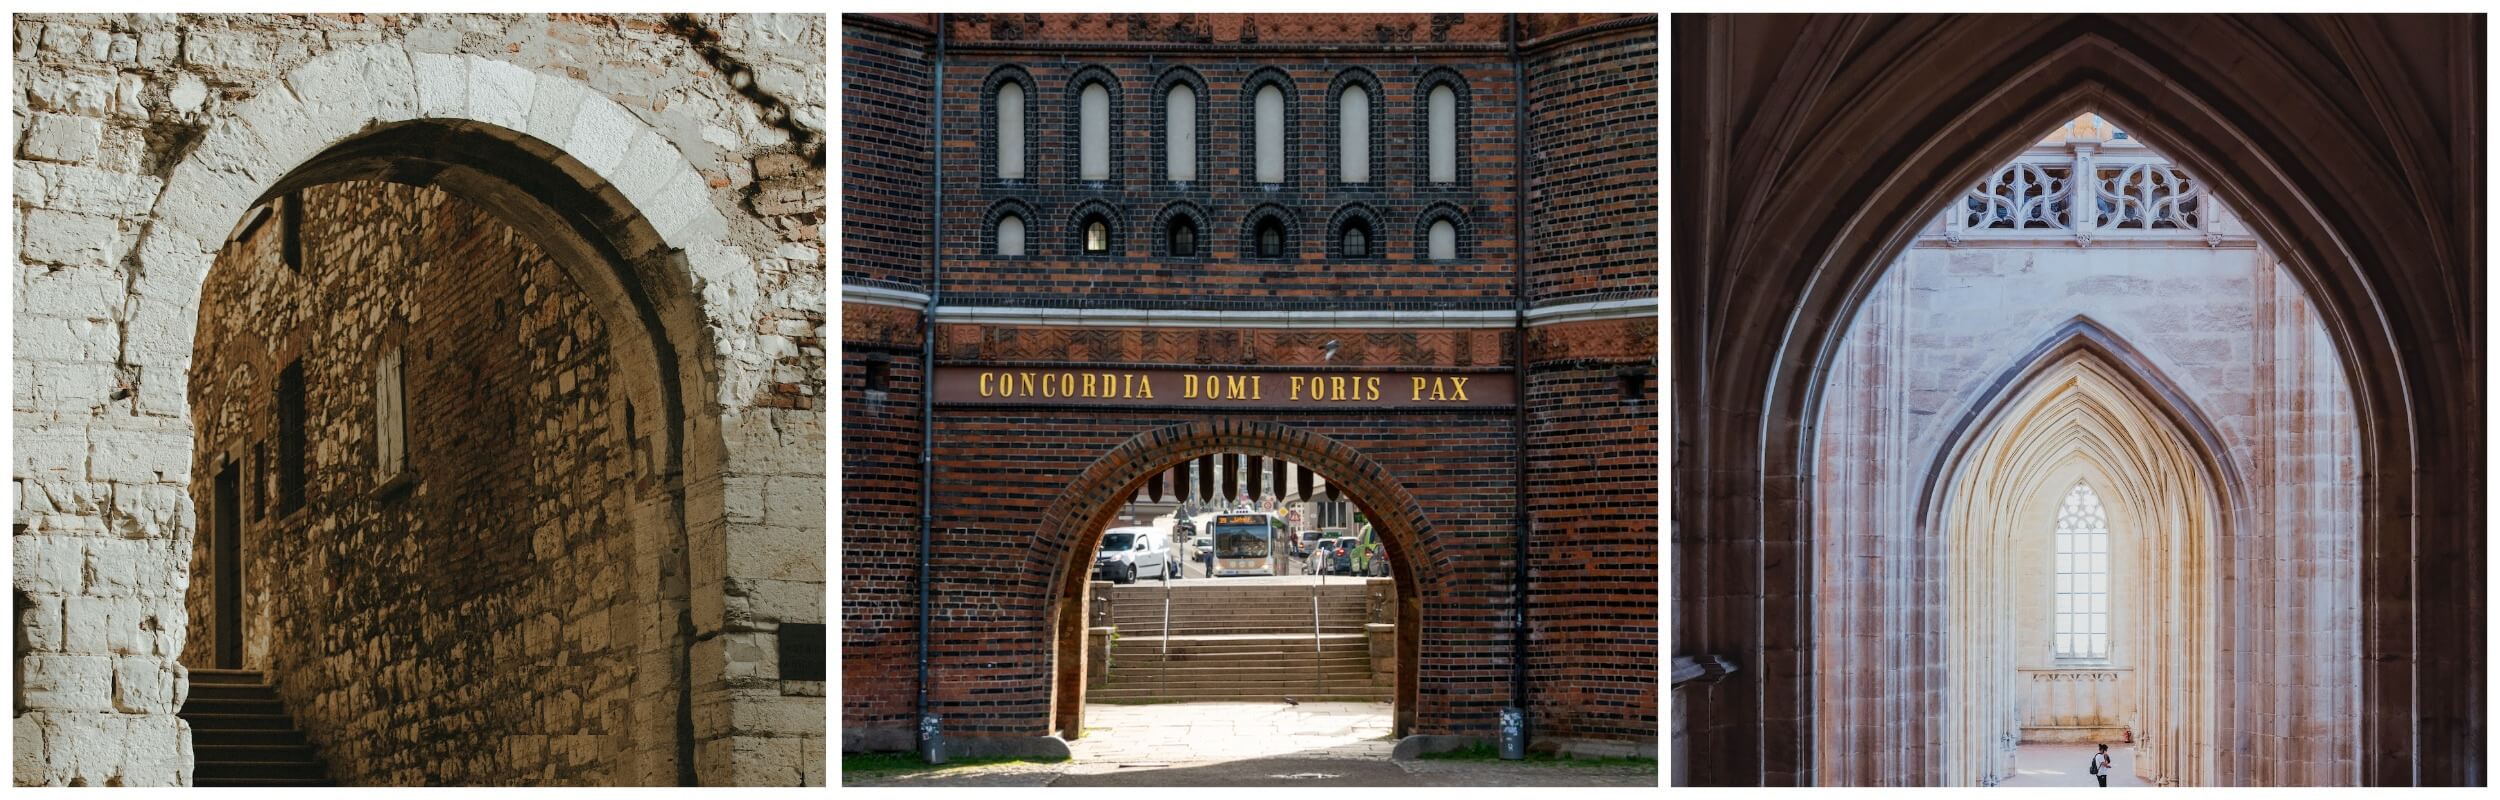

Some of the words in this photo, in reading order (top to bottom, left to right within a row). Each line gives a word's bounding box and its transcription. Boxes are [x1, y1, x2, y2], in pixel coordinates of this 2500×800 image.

[979, 371, 1153, 399] CONCORDIA
[1183, 373, 1261, 400] DOMI
[1290, 375, 1381, 401] FORIS
[1412, 376, 1468, 401] PAX
